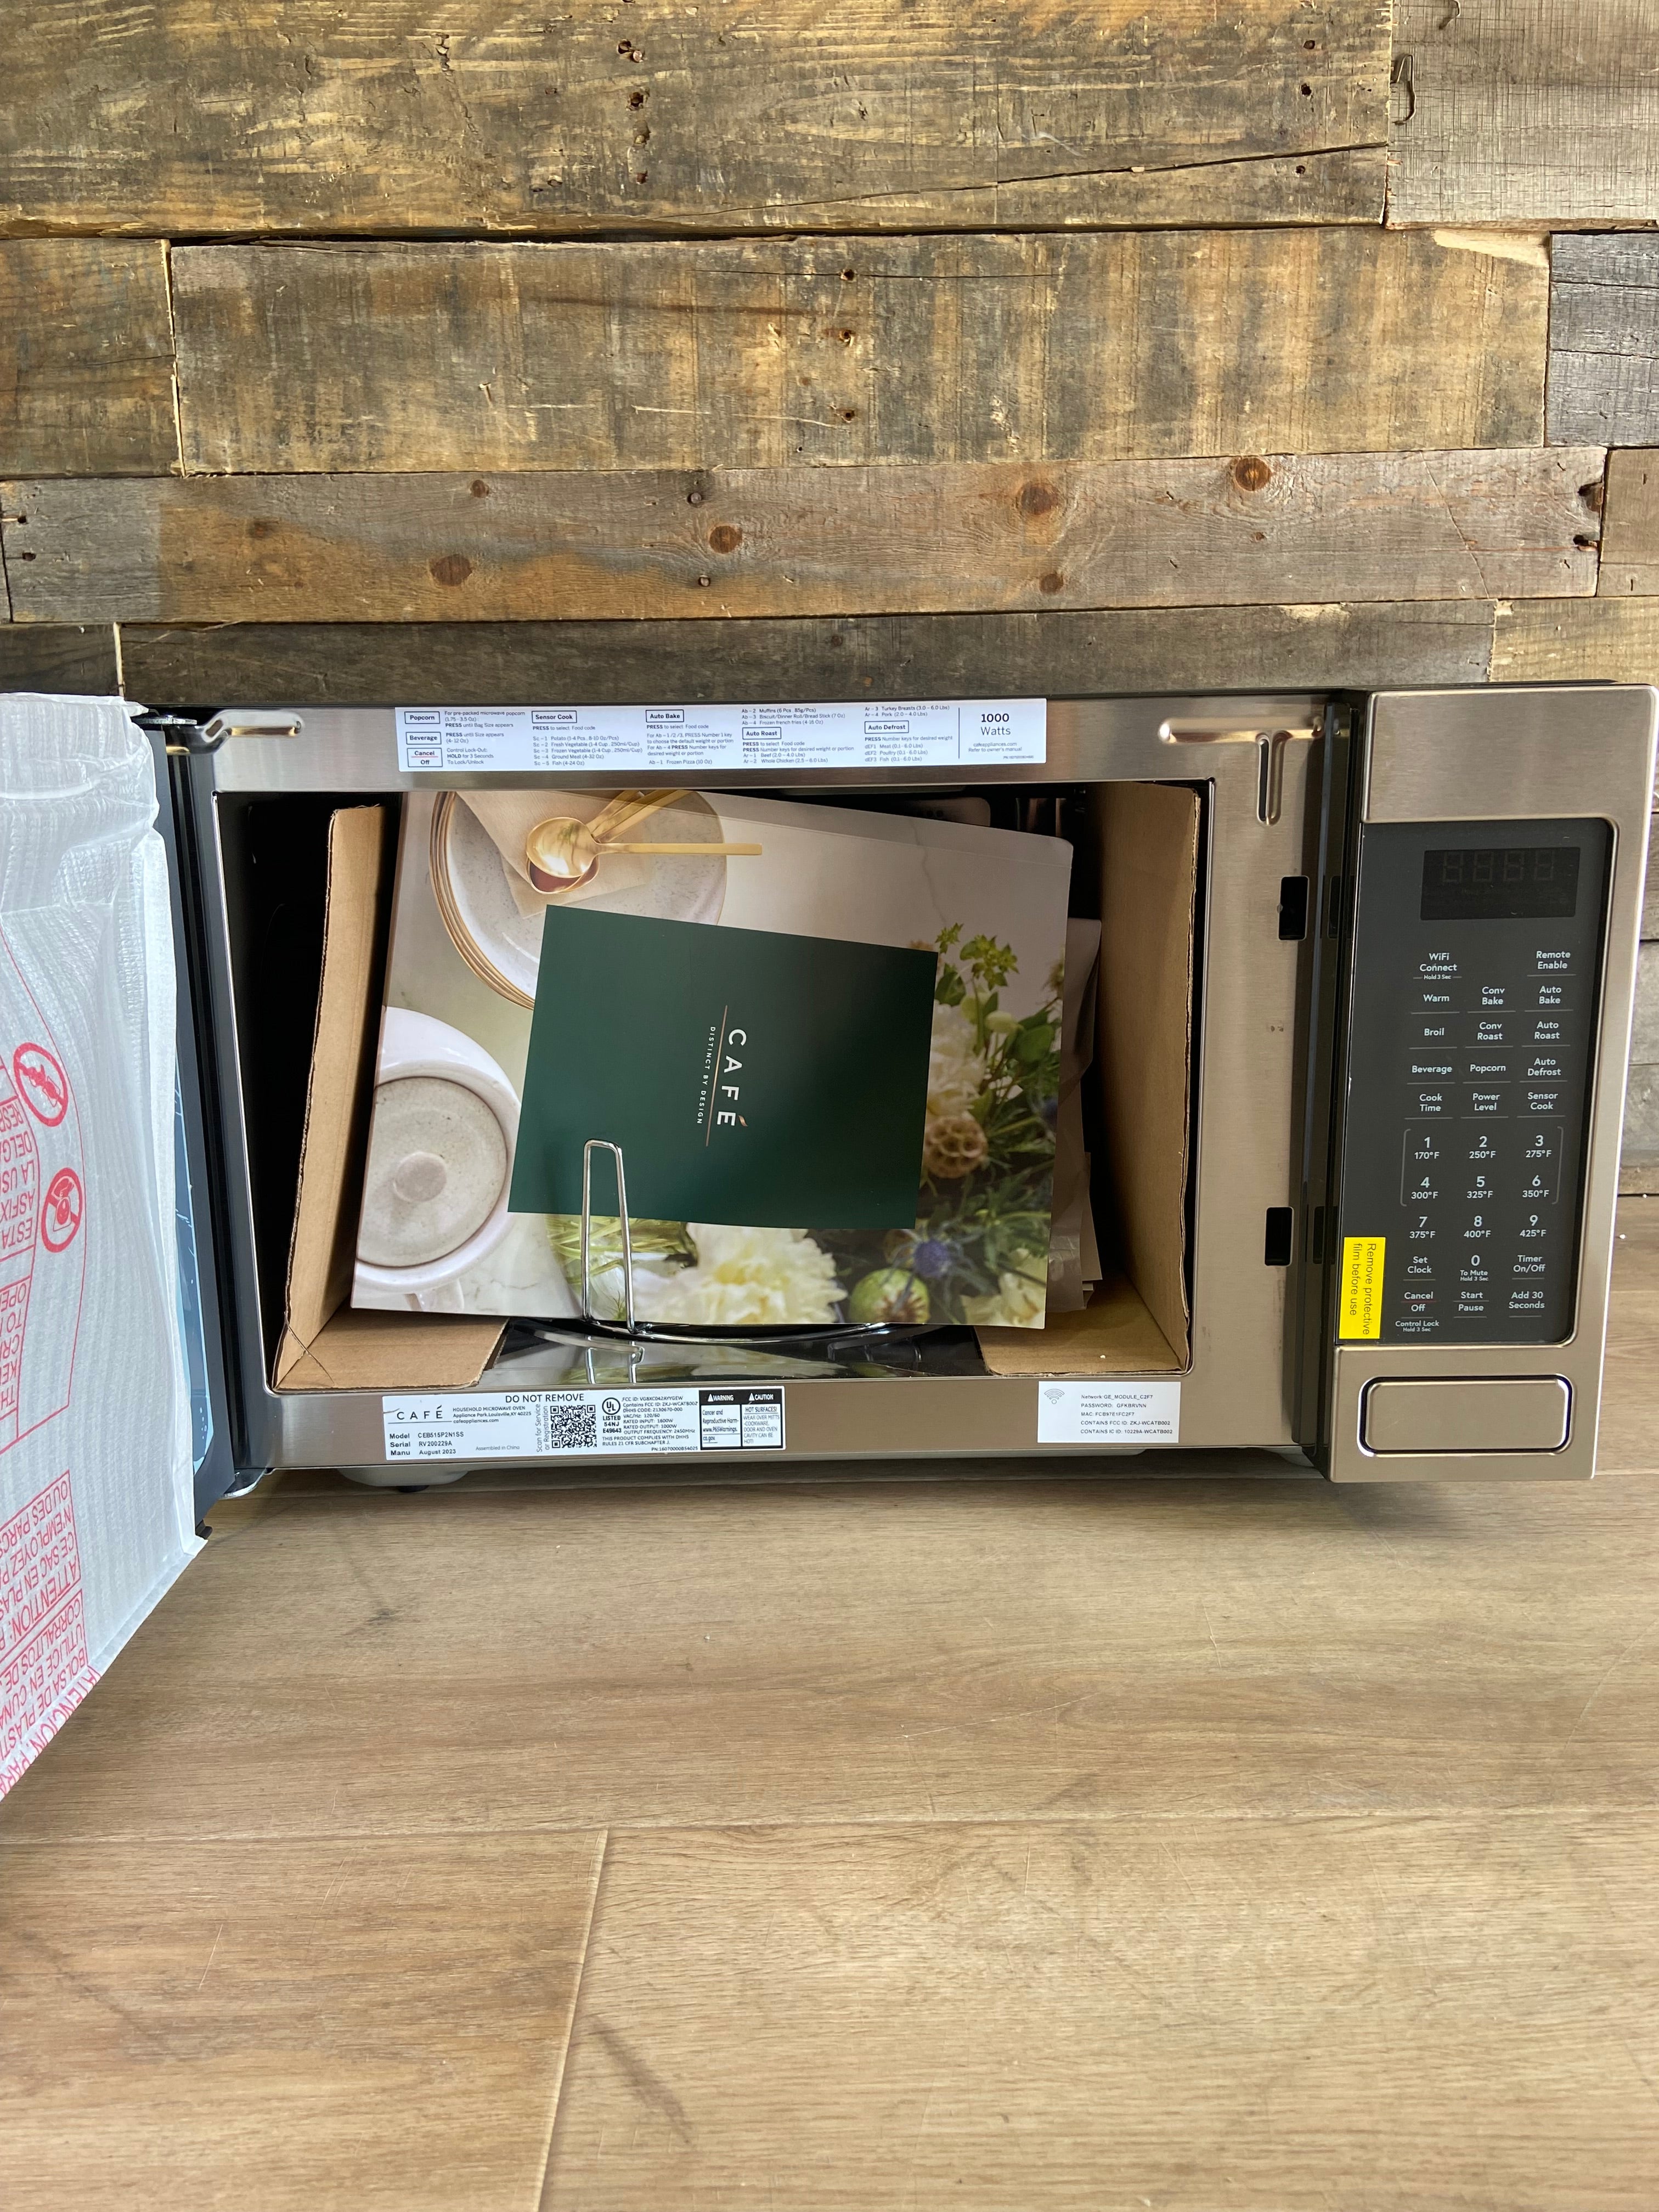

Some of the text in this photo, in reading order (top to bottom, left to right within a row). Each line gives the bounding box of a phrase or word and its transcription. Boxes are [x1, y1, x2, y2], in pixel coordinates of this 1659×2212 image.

[981, 713, 1009, 723] 1000
[980, 726, 1011, 735] Watts
[1429, 952, 1450, 961] WiFi
[1536, 950, 1571, 960] Remote
[1419, 962, 1458, 973] Connect
[1537, 960, 1568, 970] Enable
[1482, 986, 1505, 995] Conv
[1539, 986, 1562, 994] Auto
[1423, 994, 1450, 1003] Warm
[1482, 997, 1504, 1006] Bake
[1539, 996, 1561, 1005] Bake
[1479, 1022, 1503, 1030] Conv
[1537, 1021, 1559, 1030] Auto
[1424, 1028, 1444, 1036] Broil
[1477, 1032, 1503, 1041] Roast
[1534, 1031, 1560, 1040] Roast
[1534, 1058, 1556, 1066] Auto
[1412, 1065, 1453, 1075] Beverage
[1470, 1064, 1506, 1073] Popcorn
[1527, 1068, 1561, 1077] Defrost
[697, 1026, 716, 1124] DISTINCT BY DESIGN
[717, 1029, 748, 1127] CAFÉ
[1419, 1093, 1442, 1102] Cook
[1472, 1093, 1500, 1101] Power
[1527, 1092, 1559, 1100] Sensor
[1420, 1104, 1441, 1112] Time
[1474, 1103, 1497, 1111] Level
[1530, 1102, 1554, 1110] Cook
[1424, 1136, 1431, 1149] 1
[1479, 1136, 1488, 1148] 2
[1535, 1135, 1544, 1147] 3
[1414, 1151, 1440, 1160] 170°F
[1469, 1150, 1496, 1159] 250°F
[1525, 1149, 1552, 1158] 275°F
[1420, 1176, 1430, 1188] 4
[1476, 1176, 1485, 1188] 5
[1532, 1175, 1541, 1187] 6
[1410, 1190, 1439, 1200] 300°F
[1466, 1190, 1494, 1199] 325°F
[1522, 1189, 1550, 1198] 350°F
[1419, 1216, 1427, 1228] 7
[1474, 1216, 1482, 1227] 8
[1529, 1215, 1538, 1226] 9
[1409, 1231, 1436, 1239] 375°F
[1464, 1229, 1492, 1238] 400°F
[1519, 1229, 1547, 1237] 425°F
[1352, 1243, 1363, 1260] film
[1471, 1255, 1480, 1266] 0
[1407, 1266, 1432, 1274] Clock
[1513, 1263, 1545, 1273] On/Off
[1351, 1263, 1361, 1295] before
[1362, 1243, 1376, 1335] Remove protective
[1410, 1304, 1425, 1312] Off
[1458, 1304, 1483, 1312] Pause
[522, 1394, 543, 1403] NOT
[545, 1393, 584, 1402] REMOVE
[397, 1404, 443, 1420] CAFÉ
[32, 1481, 67, 1526] OU DES
[24, 1532, 74, 1594] CE SAC EN
[22, 1599, 80, 1675] CORRALITOS
[47, 1624, 82, 1678] UTILICE
[53, 1649, 86, 1695] BOLSA
